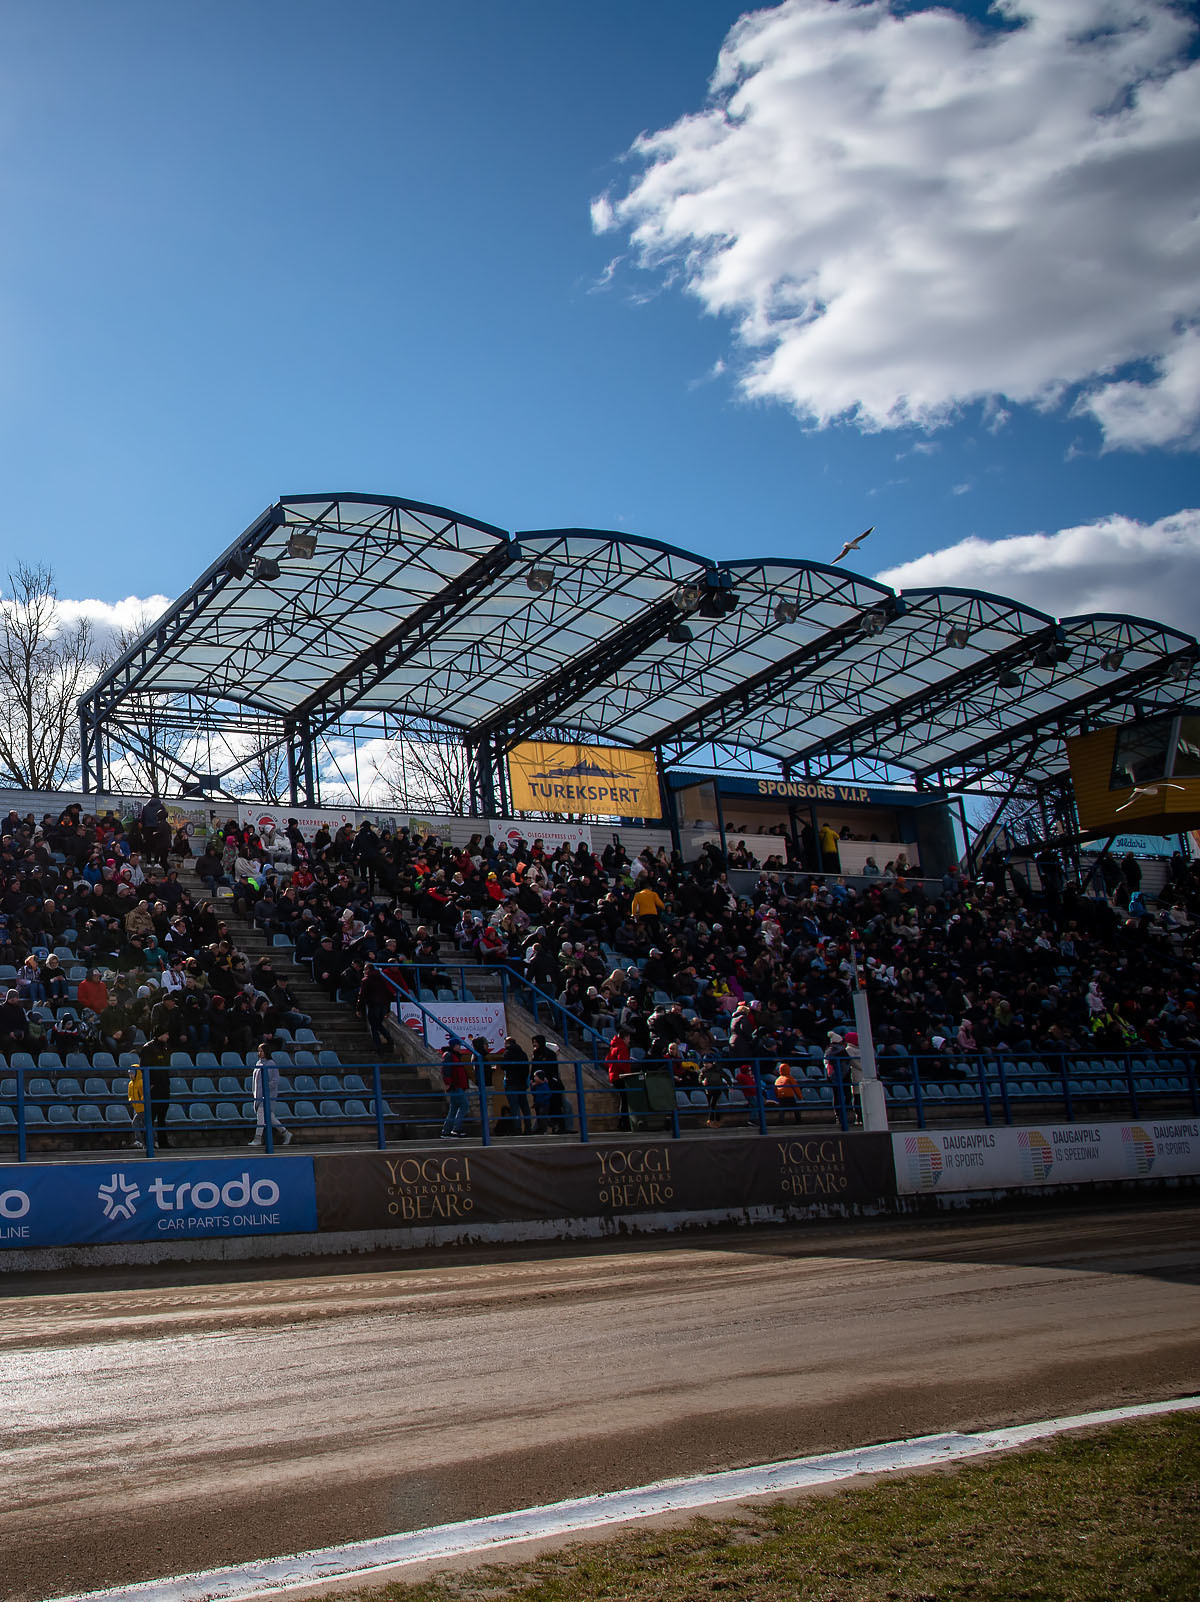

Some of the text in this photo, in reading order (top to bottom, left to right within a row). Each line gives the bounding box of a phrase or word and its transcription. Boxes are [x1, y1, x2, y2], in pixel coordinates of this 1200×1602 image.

[528, 782, 640, 803] TUREKSPERT
[757, 780, 871, 803] SPONSORS V.I.P.
[428, 1016, 480, 1024] OEGSEXPRESS
[1052, 1129, 1101, 1144] DAUGAVPILS
[1153, 1124, 1199, 1139] DAUGAVPILS
[942, 1134, 996, 1150] DAUGAVPILS
[1157, 1141, 1191, 1156] IR SPORTS
[777, 1140, 845, 1165] YOGGI
[945, 1153, 984, 1168] IR SPORTS
[1055, 1147, 1100, 1161] IS SPEEDWAY
[595, 1148, 671, 1175] YOGGI
[779, 1164, 846, 1175] GASTROBARS
[385, 1157, 471, 1185] YOGGI
[597, 1174, 672, 1185] GASTROBARS
[148, 1172, 280, 1211] trodo
[387, 1183, 472, 1196] GASTROBARS
[791, 1173, 841, 1196] BEAR
[610, 1183, 666, 1208] BEAR
[401, 1194, 464, 1220] BEAR
[157, 1213, 280, 1231] CAR PARTS ONLINE
